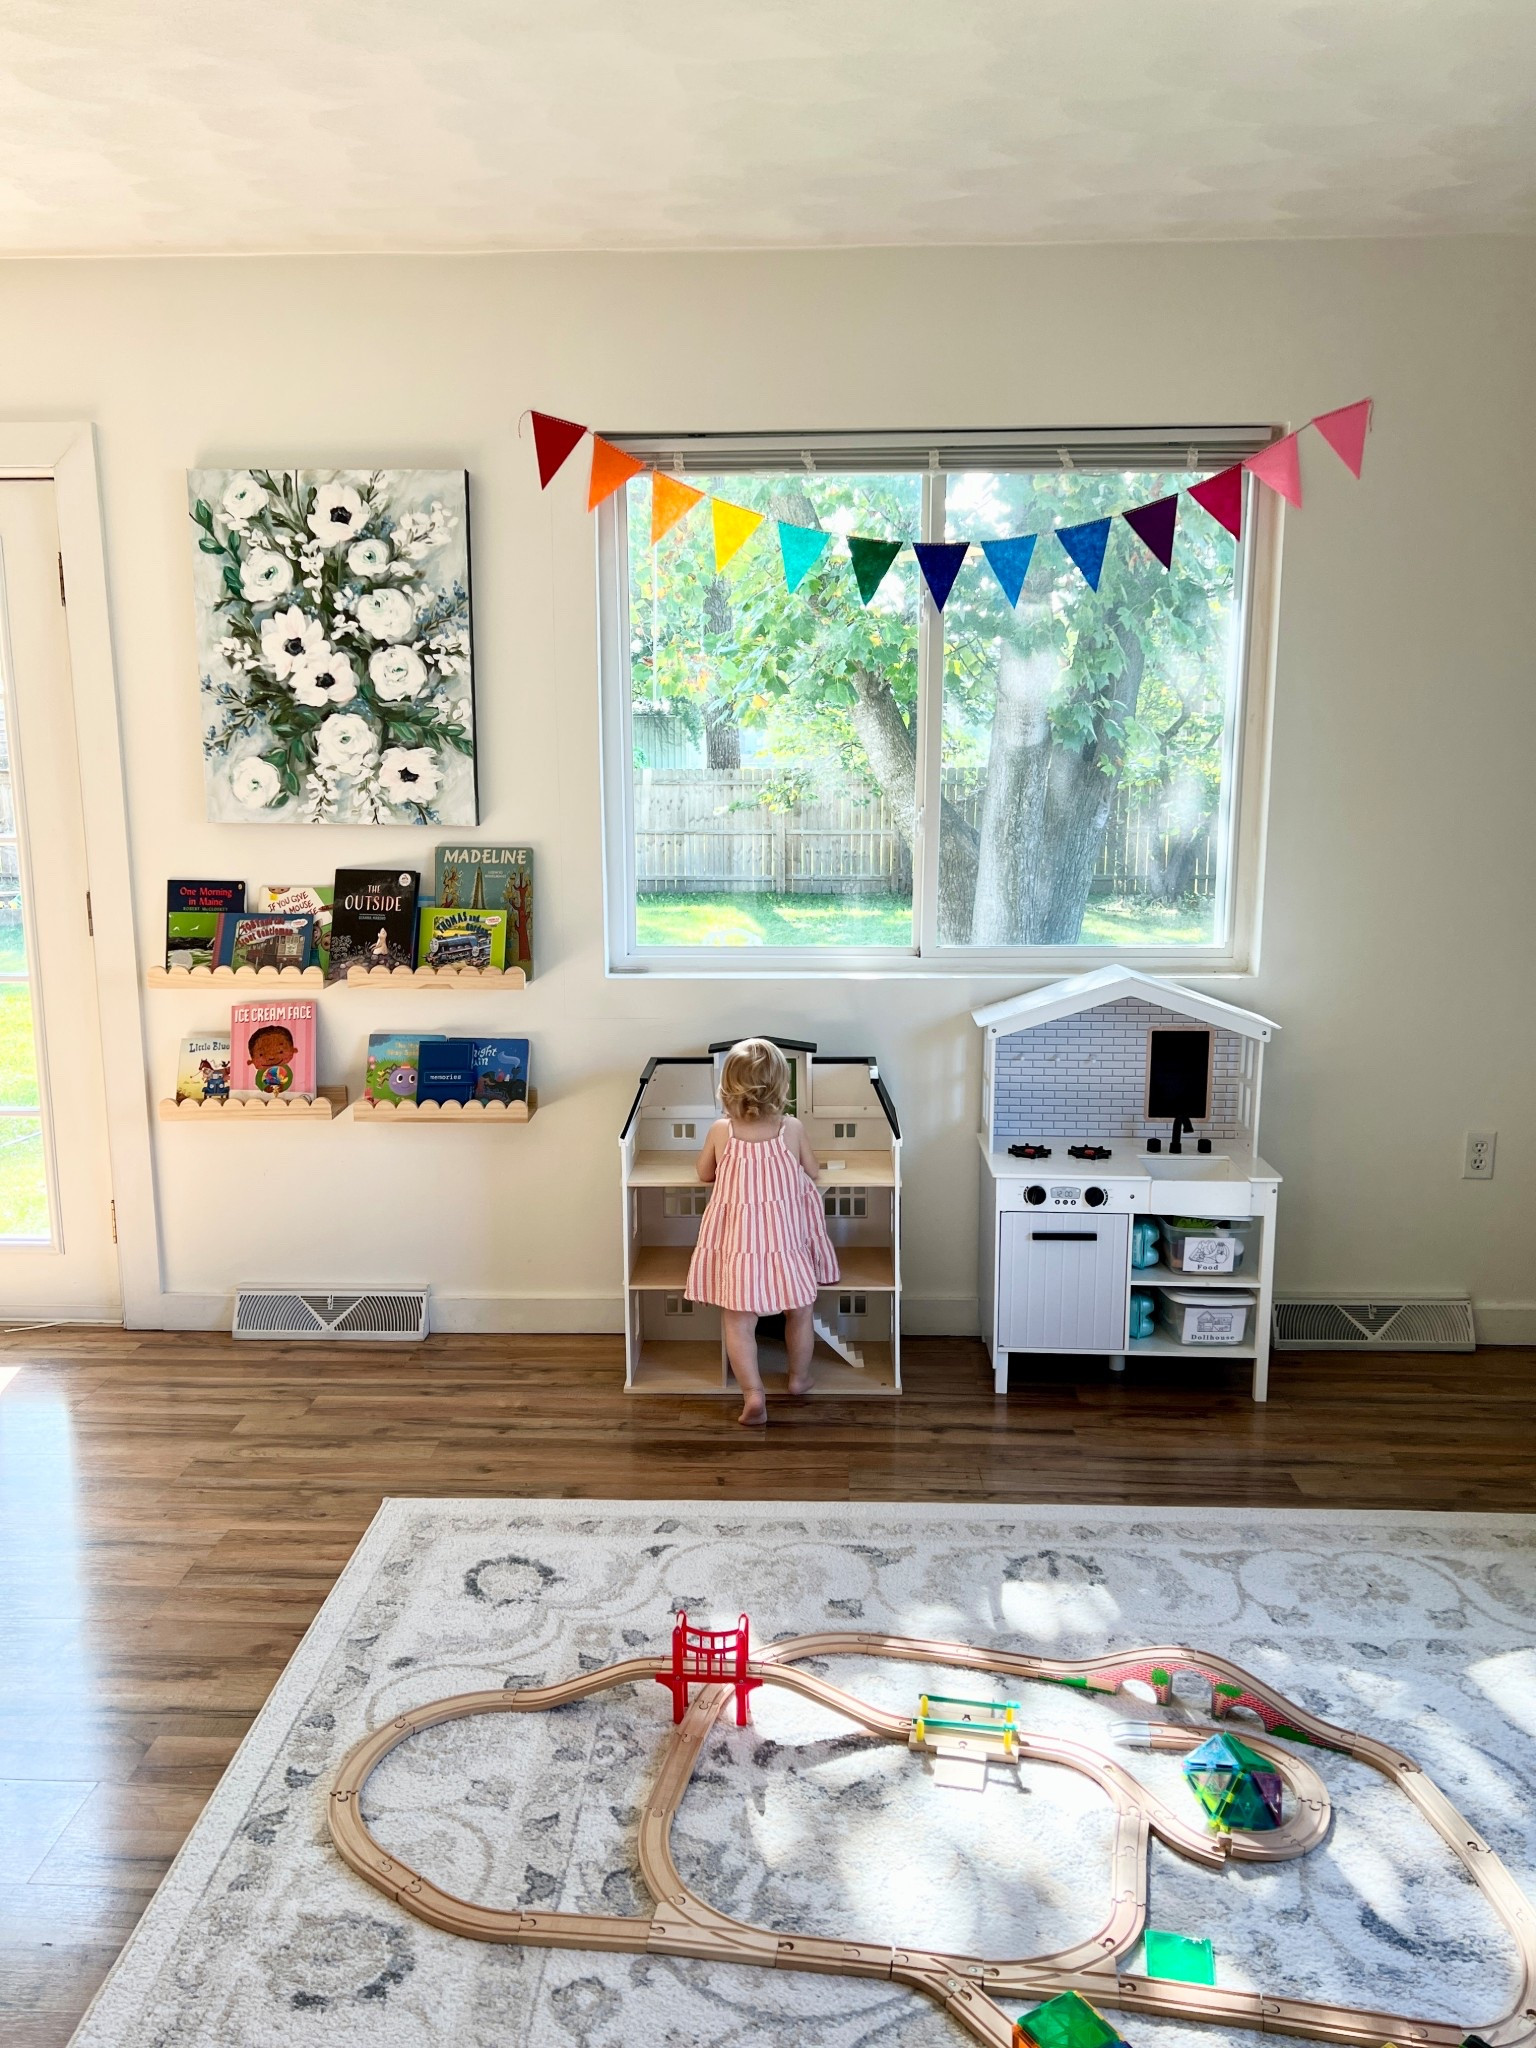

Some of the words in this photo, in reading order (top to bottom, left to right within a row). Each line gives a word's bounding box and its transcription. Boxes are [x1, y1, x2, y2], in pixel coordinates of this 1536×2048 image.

[444, 849, 526, 865] MADELINE
[180, 887, 197, 896] One
[200, 888, 233, 898] Morning
[368, 885, 381, 893] THE
[189, 897, 197, 906] in
[199, 898, 224, 906] Maine
[268, 903, 276, 912] IF
[277, 896, 290, 908] YOU
[291, 891, 309, 903] GIVE
[288, 900, 314, 914] MOUSE
[344, 895, 402, 911] OUTSIDE
[436, 911, 468, 934] THOMAS
[235, 1009, 250, 1023] ICE
[251, 1007, 286, 1022] CREAM
[288, 1005, 312, 1020] FACE
[189, 1043, 211, 1053] Little
